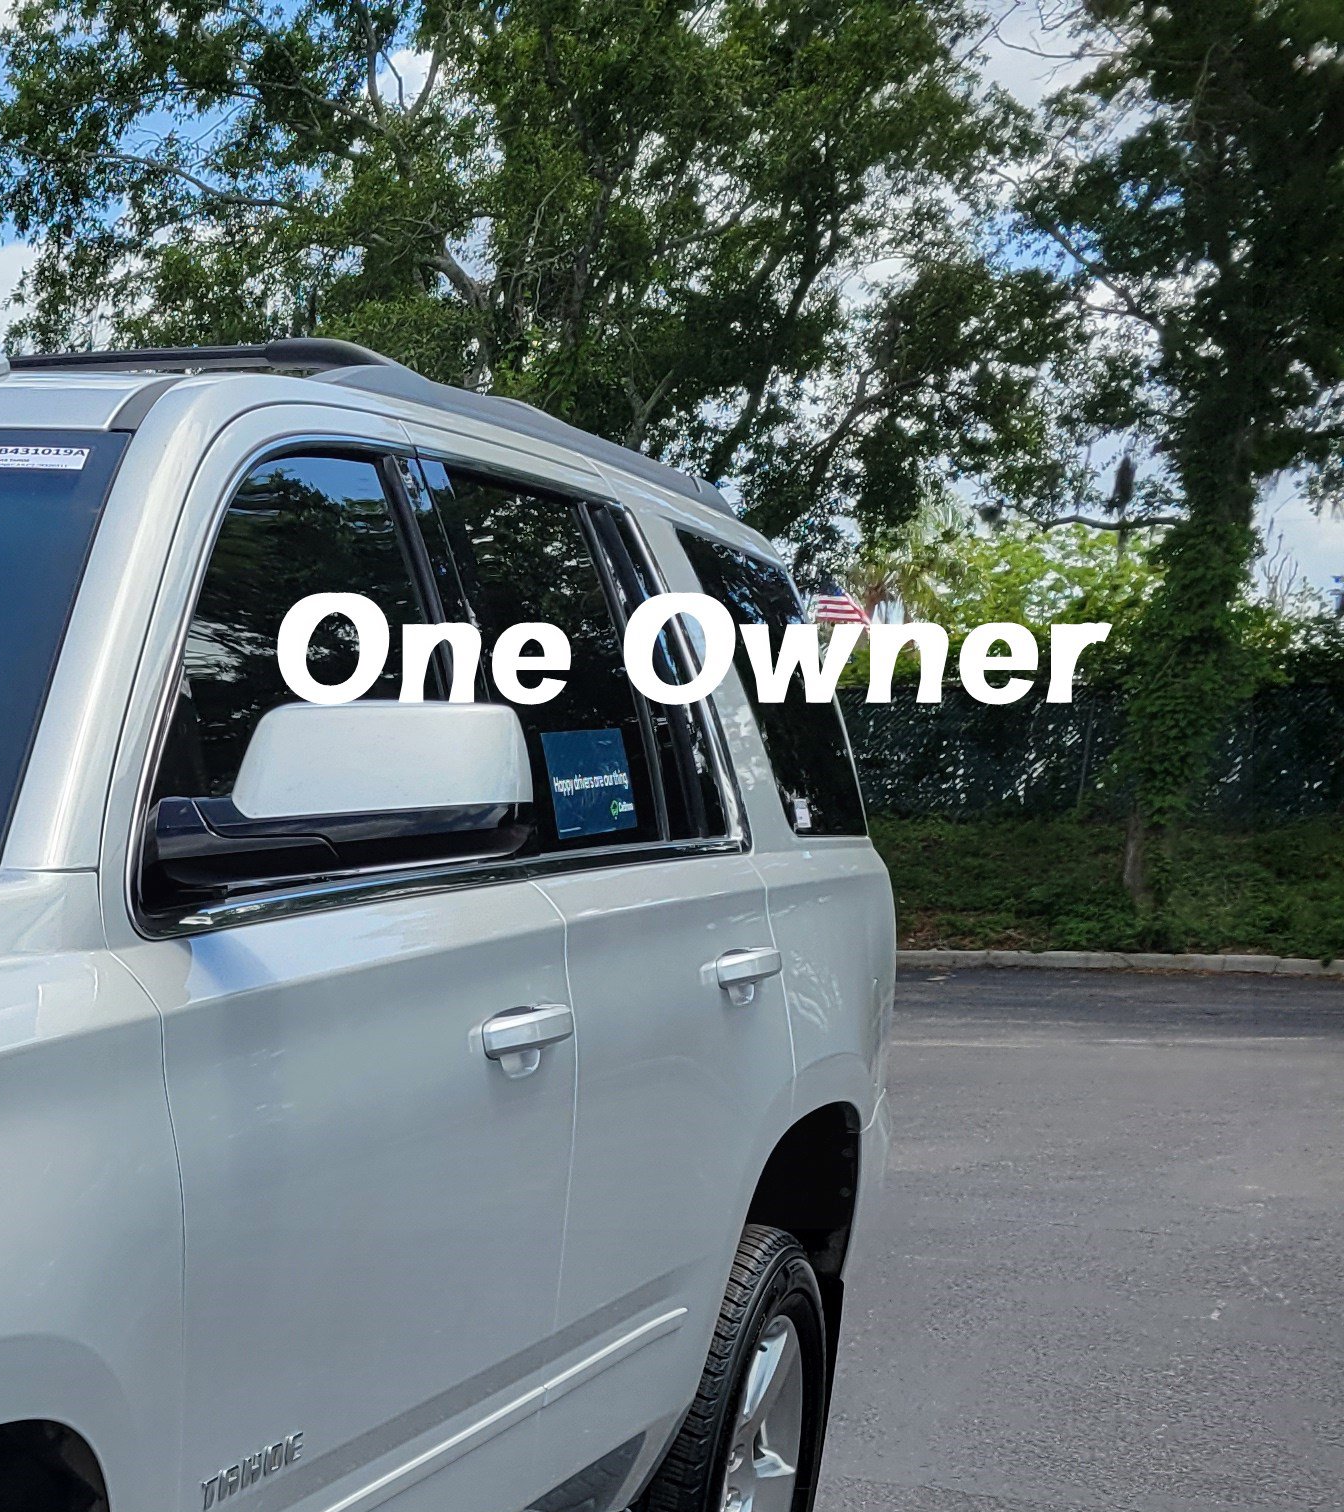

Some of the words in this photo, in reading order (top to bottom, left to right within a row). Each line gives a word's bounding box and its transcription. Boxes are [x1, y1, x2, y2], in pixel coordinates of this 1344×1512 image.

[553, 777, 574, 796] Happy
[574, 774, 594, 790] drivers
[594, 776, 604, 788] are
[201, 1431, 304, 1512] TAHOE
